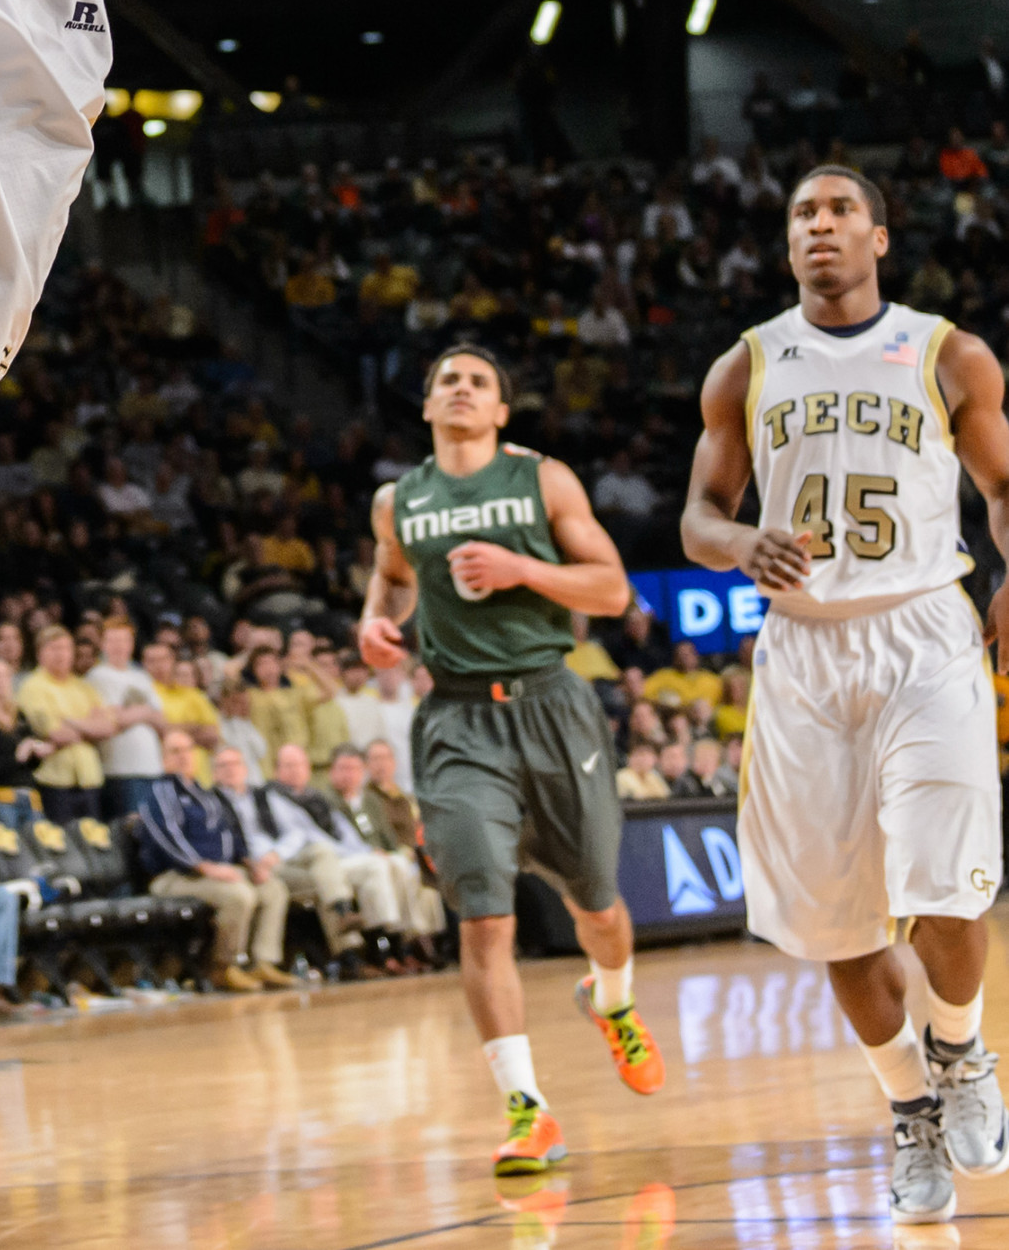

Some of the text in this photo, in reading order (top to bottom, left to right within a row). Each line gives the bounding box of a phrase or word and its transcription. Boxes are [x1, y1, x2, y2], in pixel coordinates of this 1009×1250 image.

[64, 20, 106, 33] RUSSELL
[763, 392, 924, 455] TECH
[792, 473, 897, 561] 45
